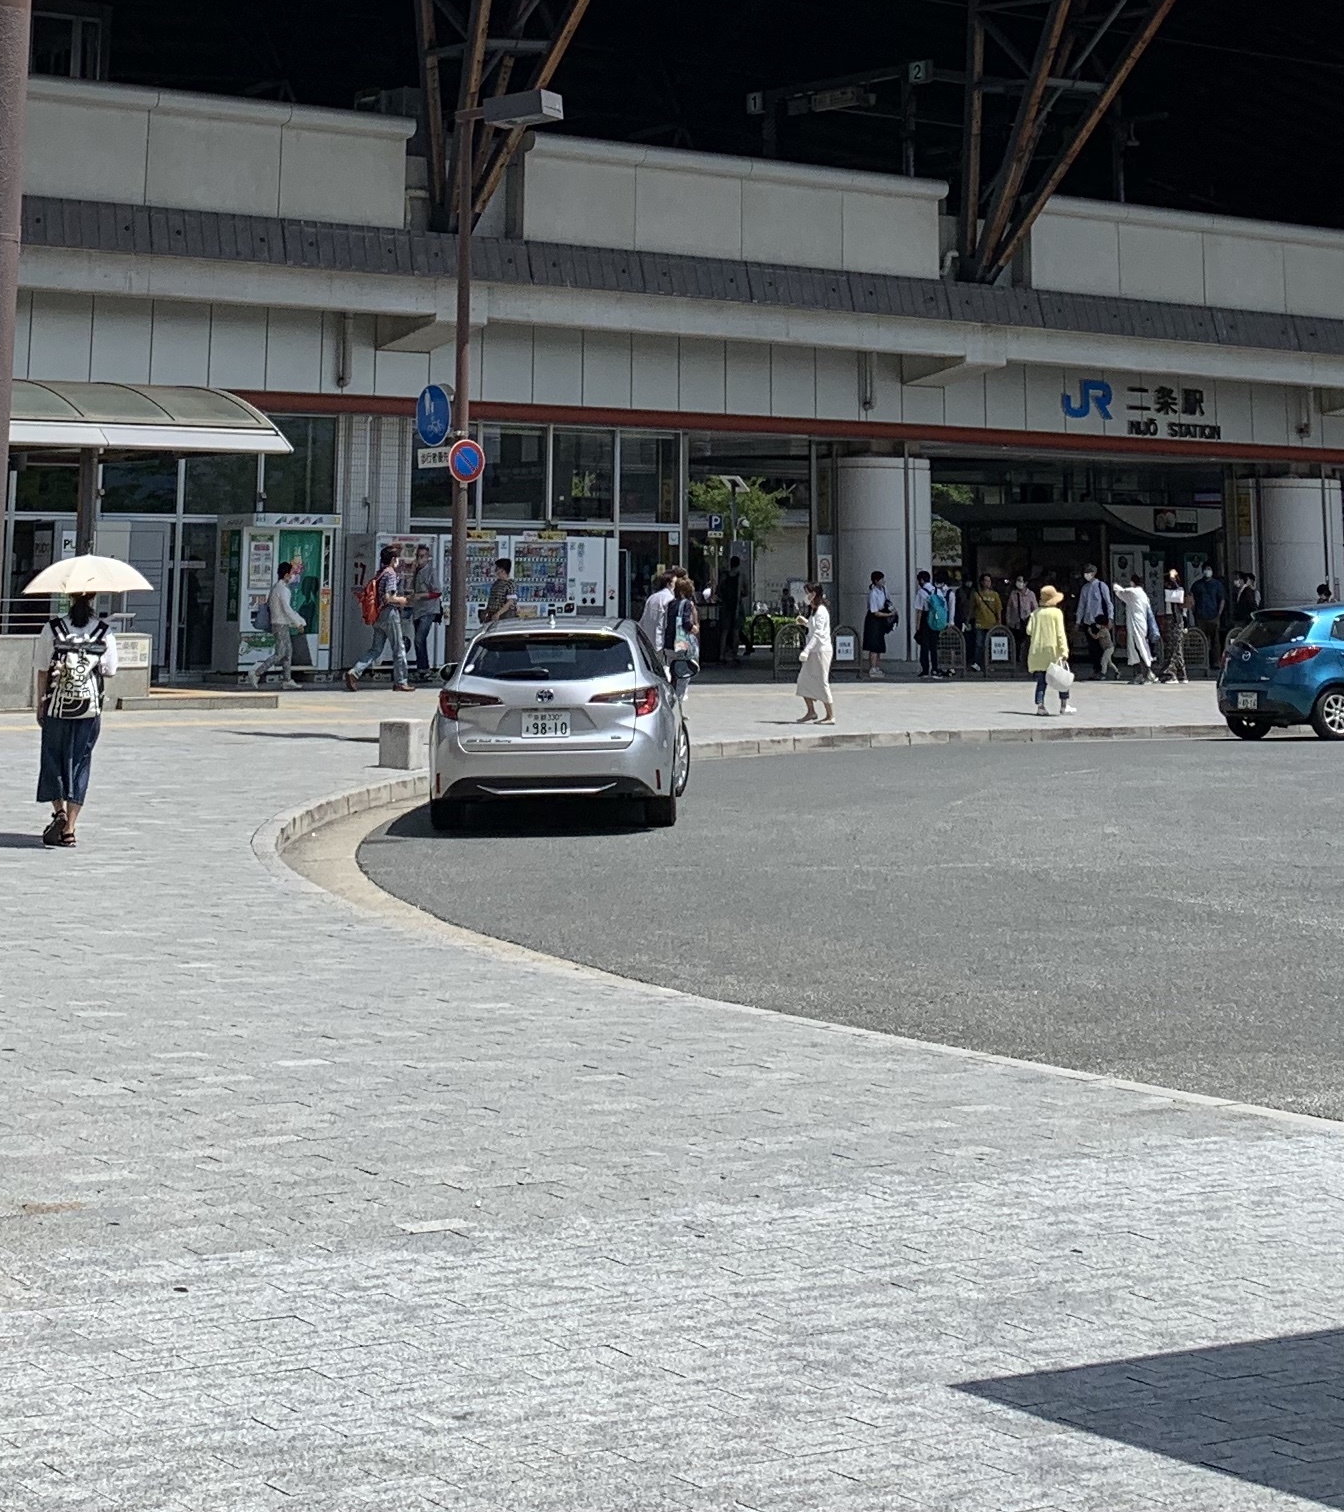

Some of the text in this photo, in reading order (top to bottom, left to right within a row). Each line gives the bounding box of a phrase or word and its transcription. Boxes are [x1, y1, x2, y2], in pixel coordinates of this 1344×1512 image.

[913, 64, 922, 80] 2
[1060, 378, 1113, 420] JR
[1126, 385, 1205, 417] 二条駅
[1167, 422, 1222, 440] STATION
[711, 515, 721, 529] P
